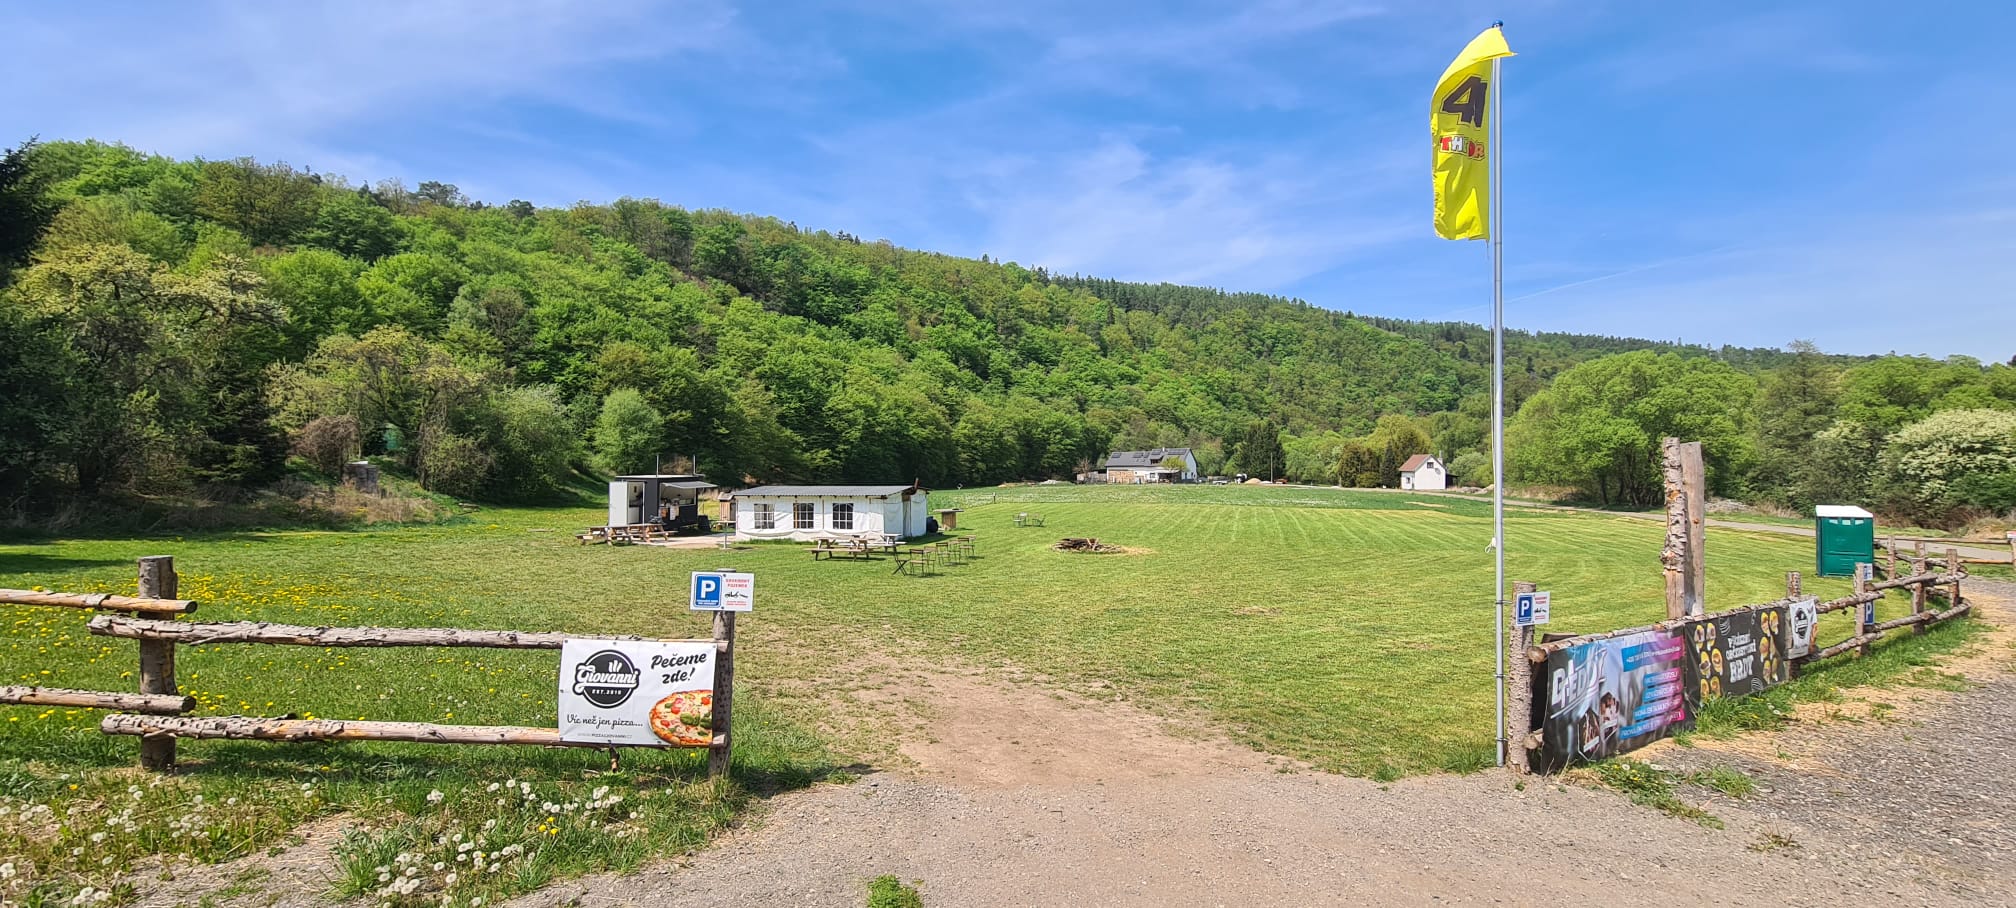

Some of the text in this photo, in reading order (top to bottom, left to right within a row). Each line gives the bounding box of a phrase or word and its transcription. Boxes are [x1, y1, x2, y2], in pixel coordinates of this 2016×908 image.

[700, 579, 716, 599] P
[1521, 600, 1530, 616] P
[651, 653, 707, 670] Pečeme
[575, 665, 639, 692] Giovanni
[662, 667, 696, 684] zde!
[567, 714, 581, 724] Víc
[582, 714, 597, 725] než
[595, 716, 611, 730] jen
